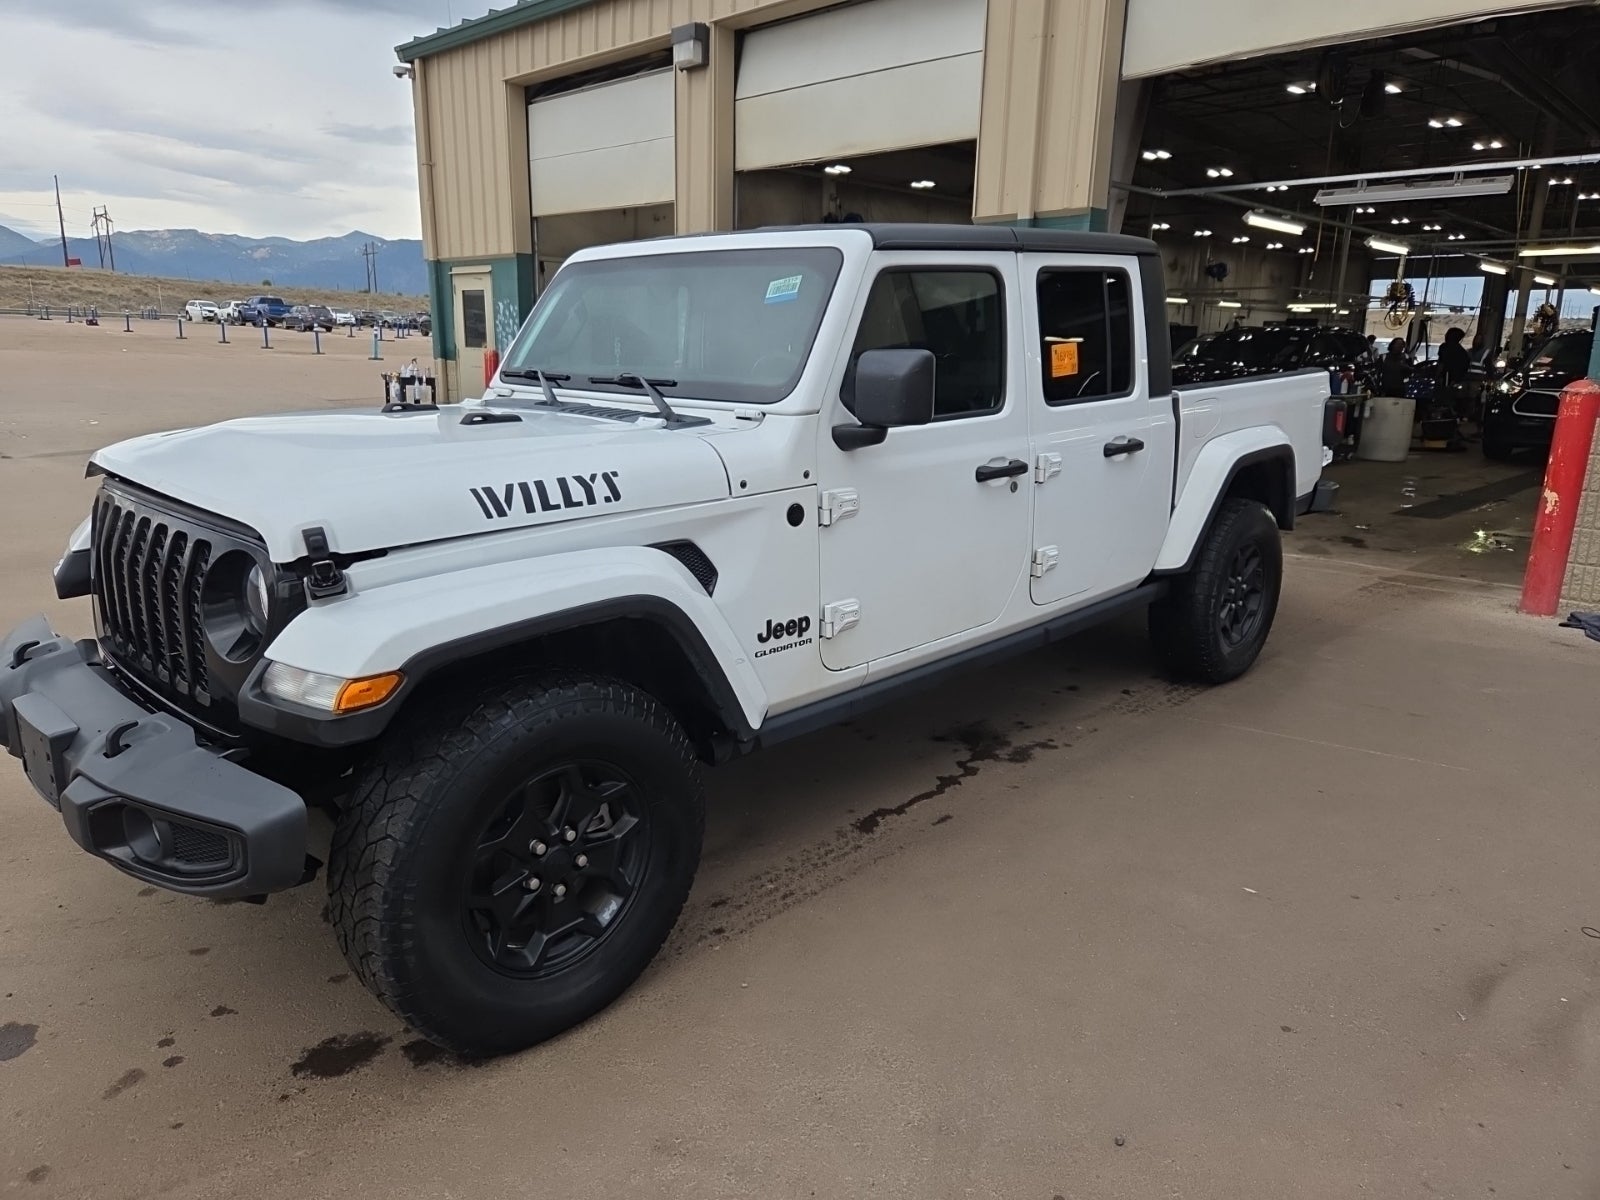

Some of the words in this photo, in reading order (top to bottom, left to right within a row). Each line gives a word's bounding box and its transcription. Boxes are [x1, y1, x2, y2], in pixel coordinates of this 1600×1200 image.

[469, 471, 622, 519] WILLYS
[757, 615, 811, 643] Jeep
[754, 637, 813, 658] GLADIATOR
